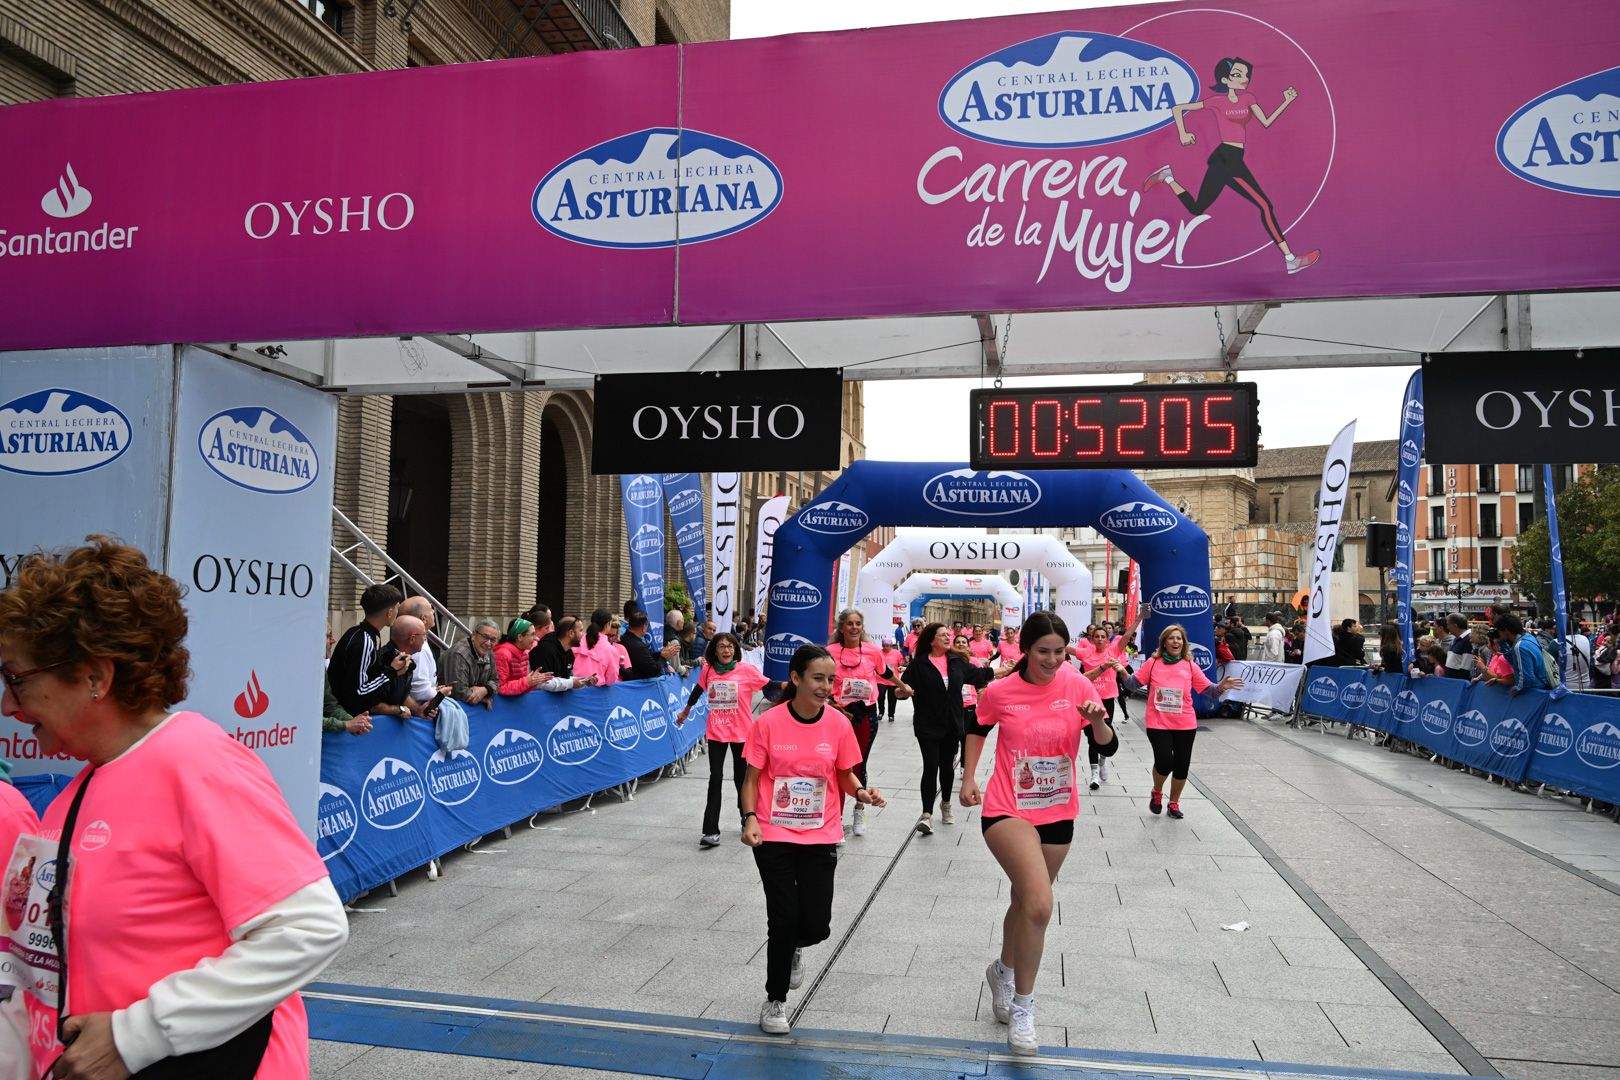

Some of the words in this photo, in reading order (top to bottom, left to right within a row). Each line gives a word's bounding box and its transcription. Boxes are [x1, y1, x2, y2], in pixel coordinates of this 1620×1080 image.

[998, 72, 1080, 87] CENTRAL
[1086, 66, 1170, 81] LECHERA
[958, 81, 1178, 123] ASTURIANA
[589, 170, 665, 185] CENTRAL
[674, 164, 755, 179] LECHERA
[916, 146, 1128, 205] Carrera
[550, 178, 763, 222] ASTURIANA
[244, 192, 415, 239] OYSHO
[967, 207, 1005, 247] de
[1015, 205, 1042, 246] la
[1036, 191, 1211, 293] Mujer
[11, 420, 60, 428] CENTRAL
[65, 418, 115, 426] LECHERA
[632, 404, 805, 440] OYSHO
[208, 427, 311, 480] ASTURIANA
[229, 429, 270, 446] CENTRAL
[272, 440, 309, 455] LECHERA
[932, 482, 1032, 503] ASTURIANA
[802, 513, 863, 527] ASTURIANA
[1106, 515, 1174, 528] ASTURIANA
[929, 541, 1021, 560] OYSHO
[193, 554, 314, 598] OYSHO
[1061, 599, 1087, 607] OYSHO
[1155, 597, 1208, 609] ASTURIANA
[767, 642, 796, 656] ASTURI
[228, 723, 297, 749] tander
[553, 734, 599, 757] ASTURIANA
[1539, 732, 1569, 748] TURIANA
[489, 749, 541, 776] ASTURIANA
[430, 767, 479, 795] ASTURIANA
[1036, 776, 1056, 785] 016
[368, 784, 423, 819] ASTURIANA
[792, 797, 811, 806] 016
